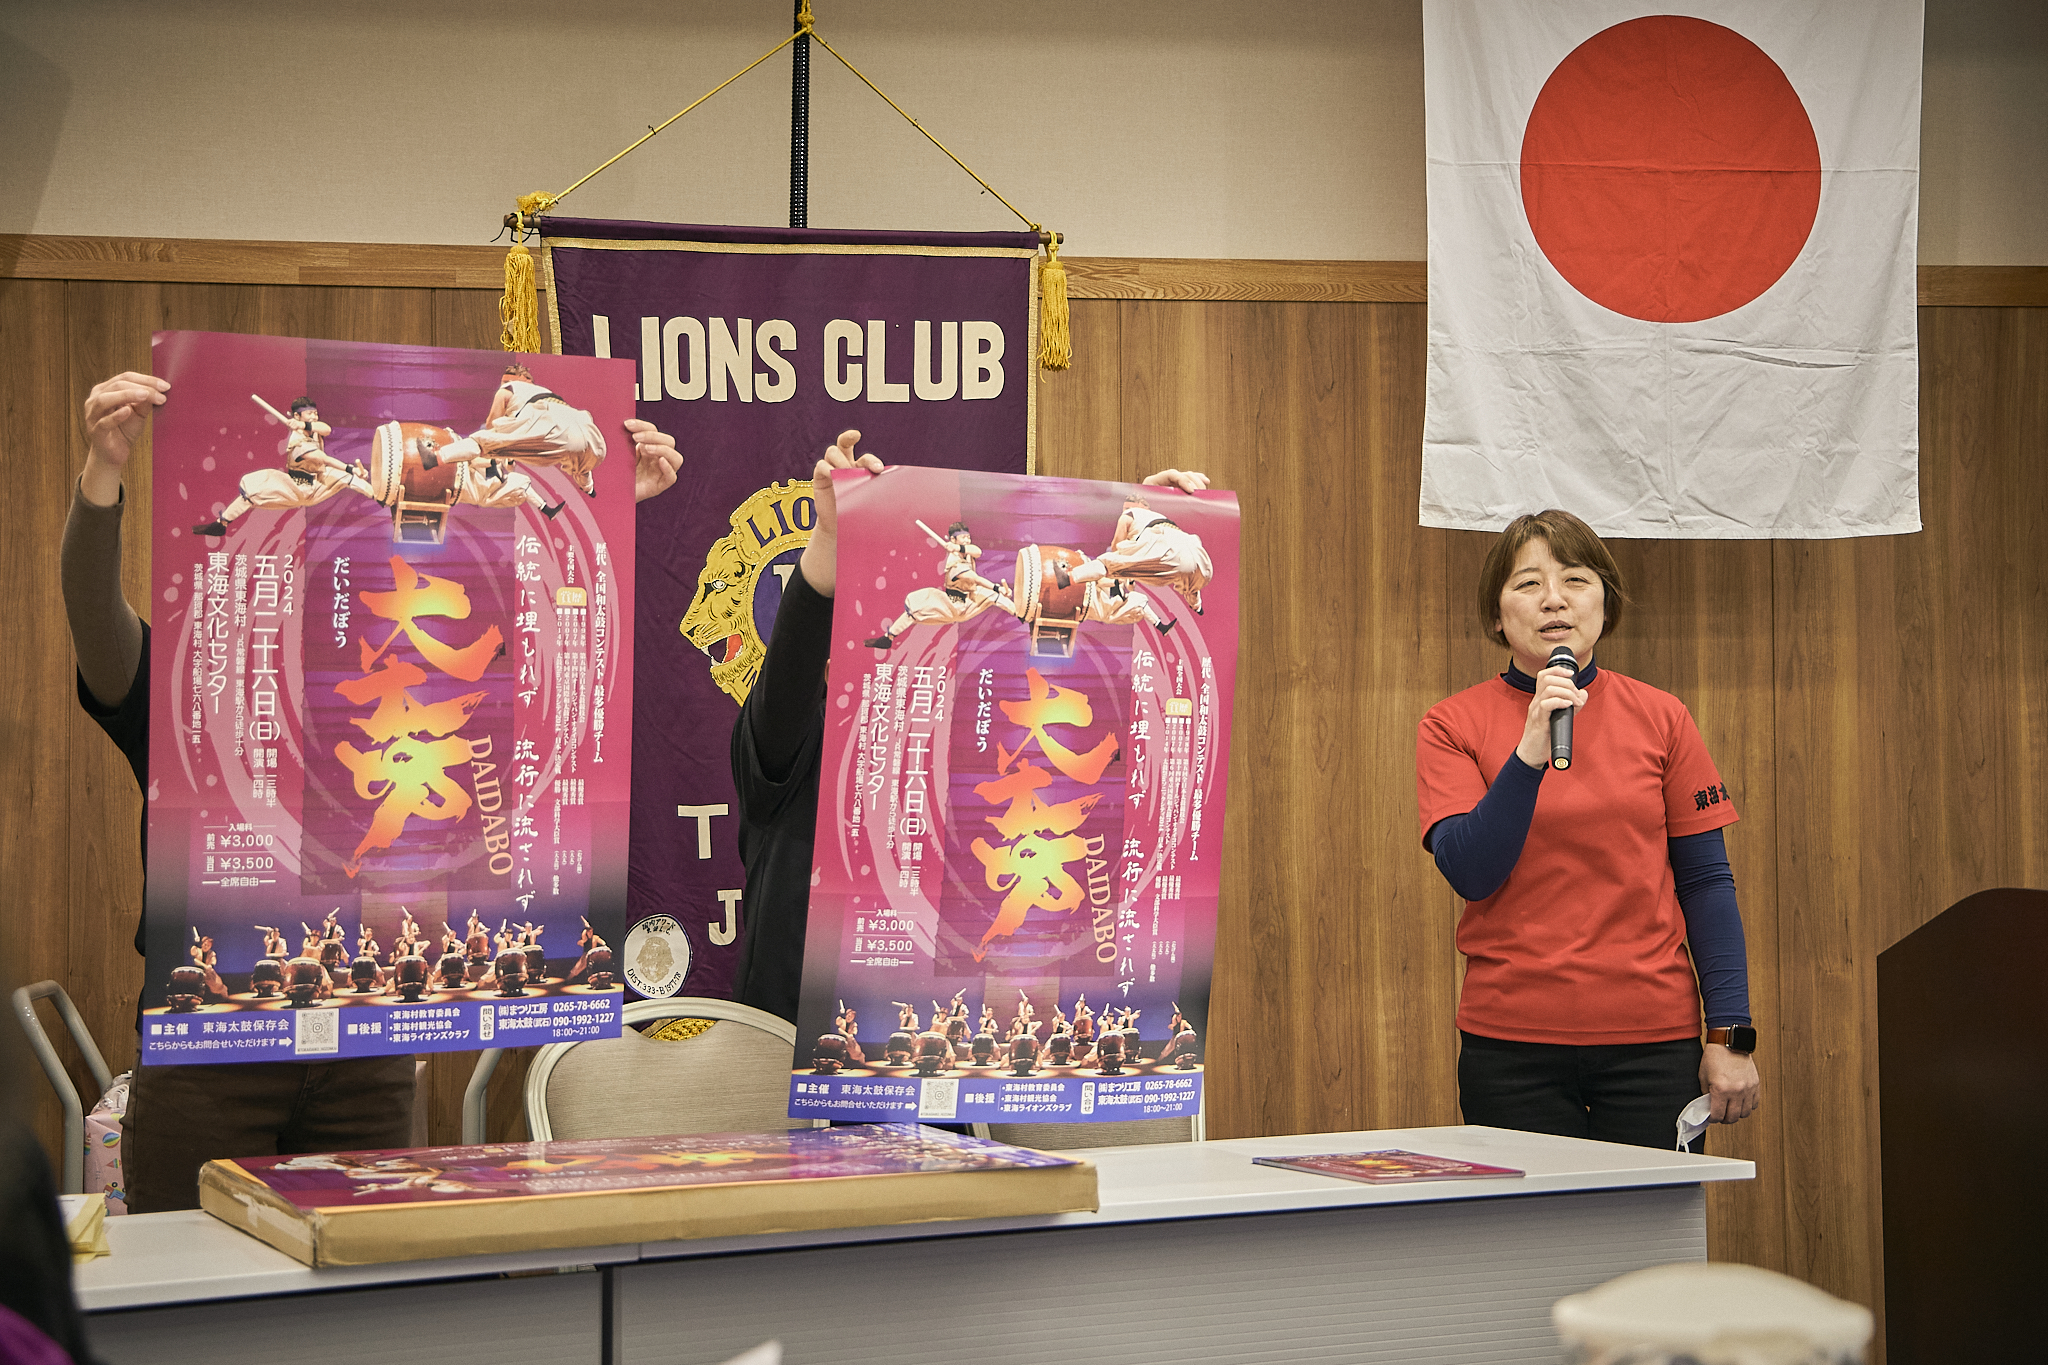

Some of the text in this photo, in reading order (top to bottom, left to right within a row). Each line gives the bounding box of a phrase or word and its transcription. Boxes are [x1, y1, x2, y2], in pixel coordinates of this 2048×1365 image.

[824, 319, 1005, 402] CLUB
[193, 563, 204, 590] 茨城県
[234, 554, 248, 627] 茨城県東海村
[283, 554, 294, 616] 2024
[333, 556, 351, 648] だいだぼう
[193, 621, 203, 648] 東海村
[207, 551, 230, 714] 東海文化センター
[593, 543, 606, 763] 歴代 全国和太鼓コンテスト 最多優勝チーム
[934, 666, 947, 722] 2024
[513, 535, 542, 912] 伝統に埋もれず 流行に流されず
[975, 668, 994, 753] だいだぼう
[867, 662, 894, 811] 東海文化センター
[252, 748, 265, 799] 開演 一四時
[266, 748, 277, 808] 開場 一三時半
[466, 734, 514, 876] DAIDABO
[220, 834, 274, 848] ¥3,000
[228, 823, 253, 832] 入場料
[206, 855, 274, 872] 当日 ¥3,500
[899, 842, 912, 888] 開演 一四時
[909, 842, 923, 896] 開場 一三時半
[220, 877, 259, 887] 全席自由
[876, 909, 897, 917] 入場料
[1084, 833, 1118, 964] DAIDABO
[868, 919, 914, 932] ¥3,000
[867, 939, 913, 952] ¥3,500
[866, 957, 899, 967] 全席自由
[553, 999, 610, 1013] 0265-78-6662
[553, 1013, 615, 1027] 090-1992-1227
[202, 1018, 289, 1034] 東海太鼓保存会
[482, 1007, 493, 1038] 問い合せ
[149, 1038, 277, 1051] こちらからもお問合せいただけます
[840, 1084, 916, 1097] 東海太鼓保存会
[1144, 1091, 1196, 1104] 090-1992-1227
[1145, 1078, 1193, 1091] 0265-78-6662
